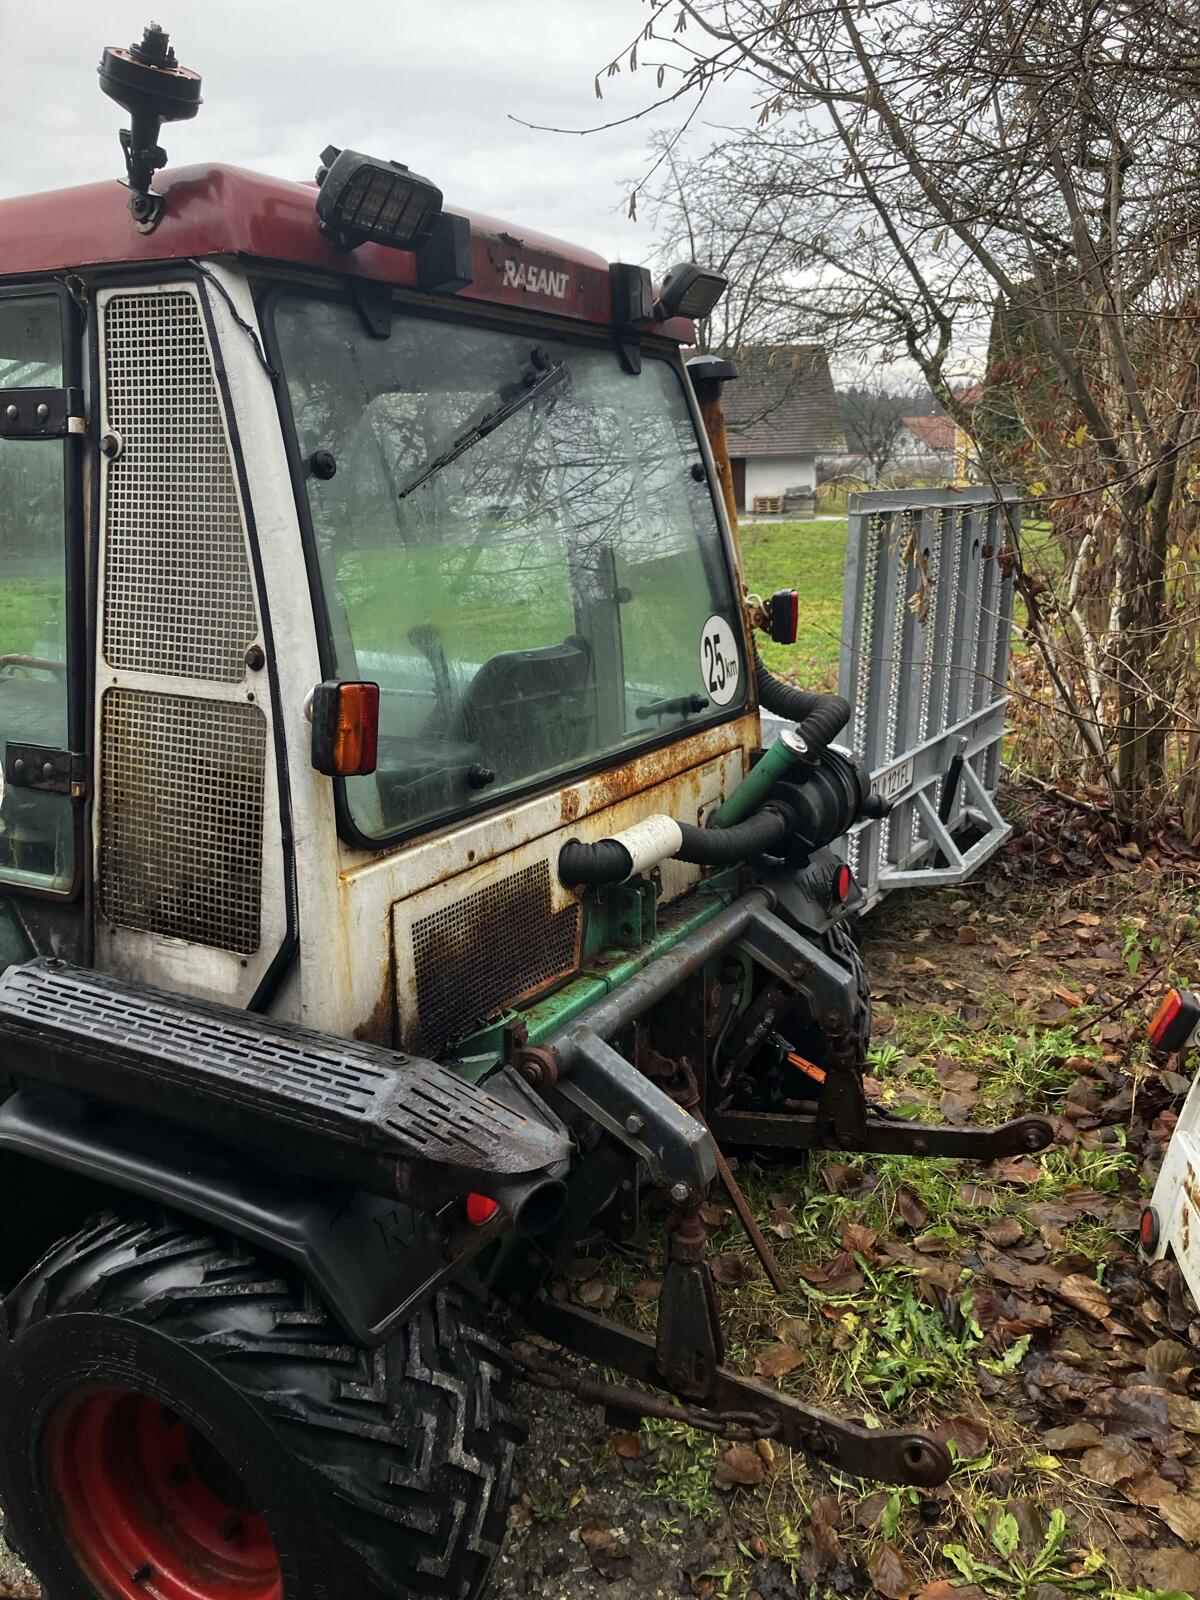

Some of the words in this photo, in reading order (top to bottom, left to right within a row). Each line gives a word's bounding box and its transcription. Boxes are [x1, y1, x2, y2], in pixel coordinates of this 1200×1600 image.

[503, 260, 570, 298] RASANT
[704, 634, 726, 693] 25
[725, 658, 738, 679] km
